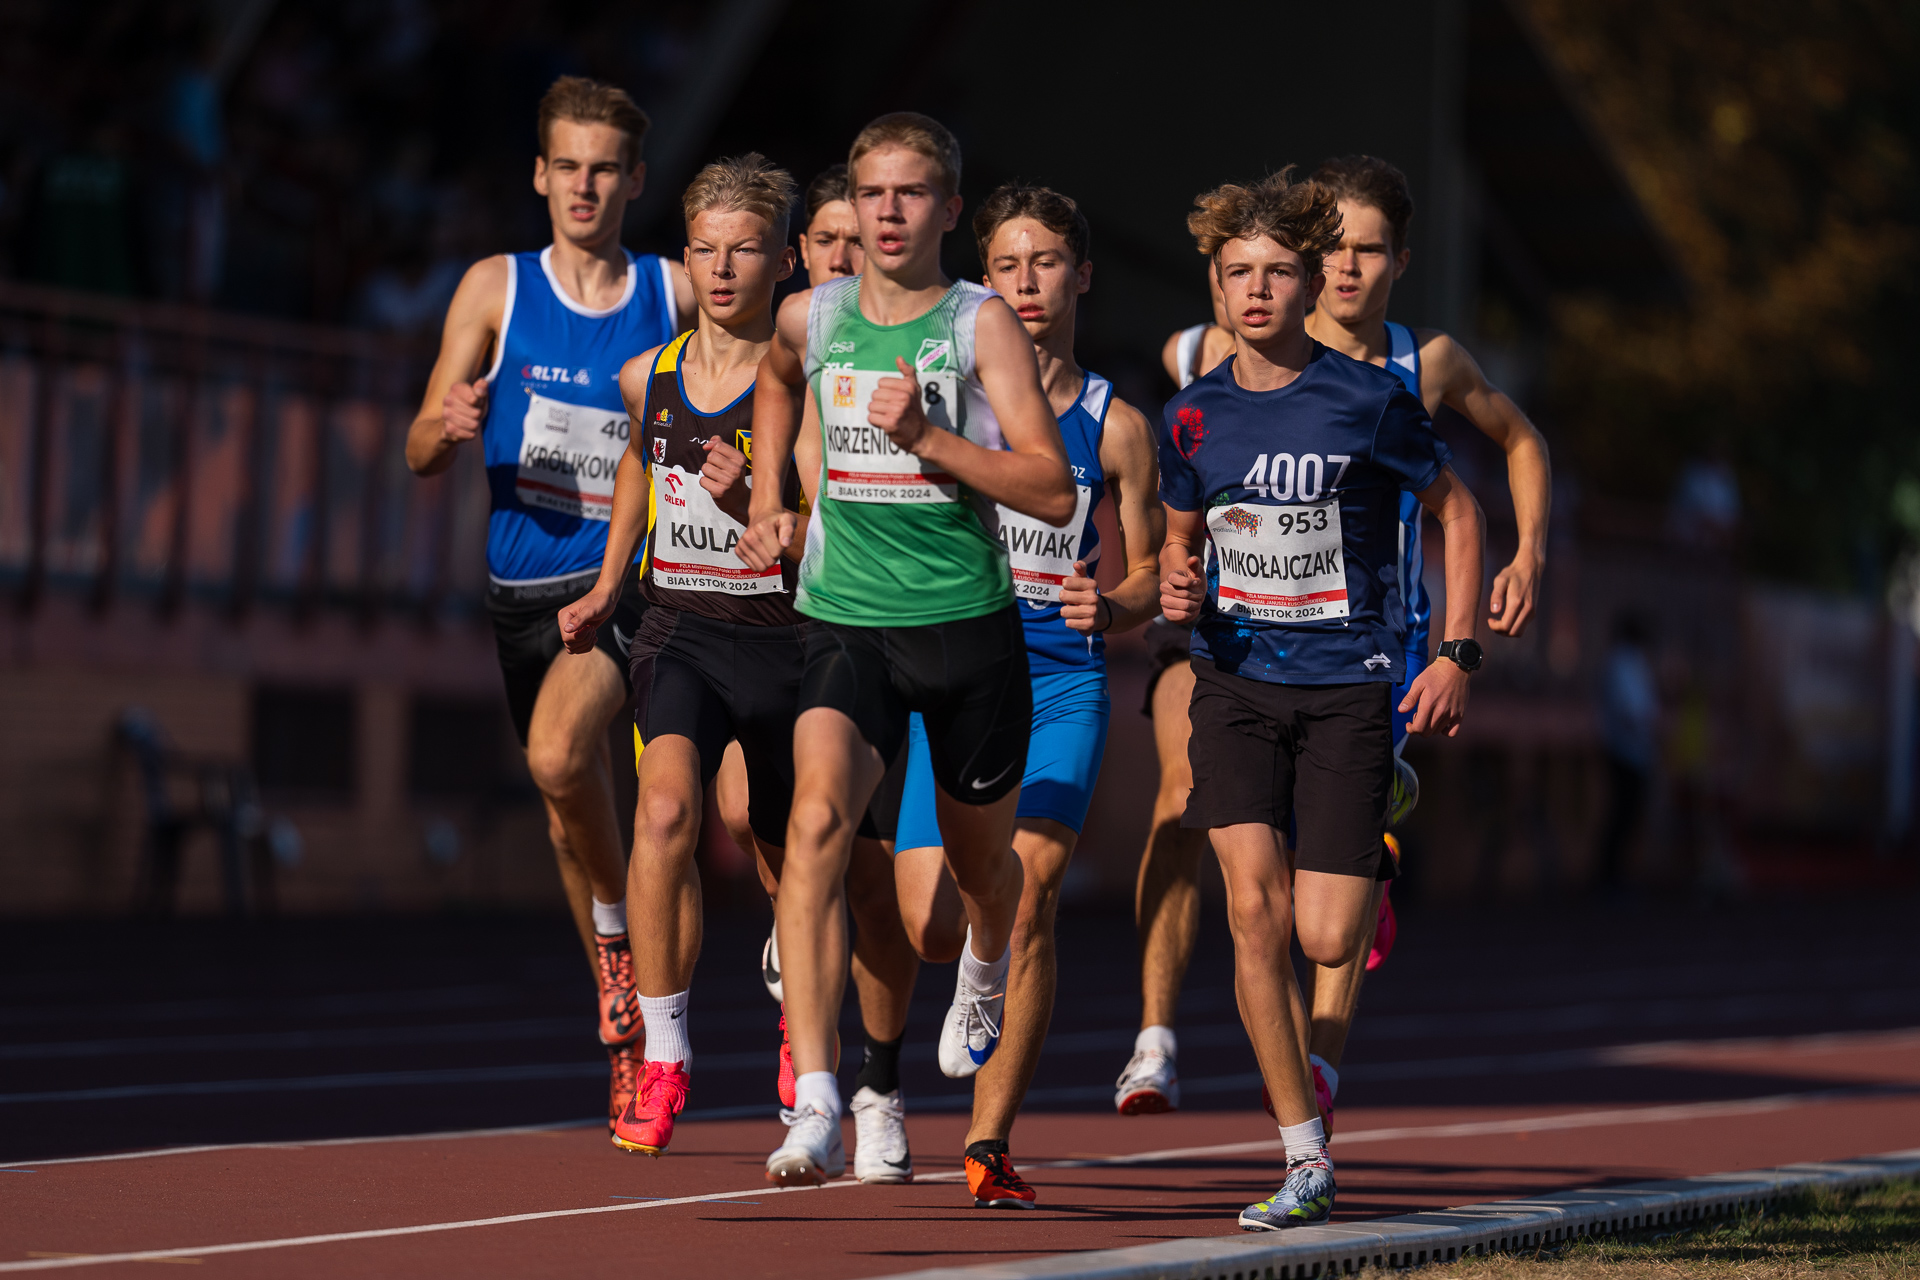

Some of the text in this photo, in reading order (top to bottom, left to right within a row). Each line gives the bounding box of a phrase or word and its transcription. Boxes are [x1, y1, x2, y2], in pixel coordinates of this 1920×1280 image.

[827, 424, 909, 456] KORZENIO
[664, 494, 686, 507] ORLEN
[838, 487, 931, 499] BIAŁYSTOK 2024
[1278, 509, 1328, 535] 953
[671, 522, 740, 553] KULA
[1221, 546, 1339, 580] MIKOŁAJCZAK
[667, 576, 757, 591] BIAŁYSTOK 2024
[1022, 584, 1050, 597] 2024
[1237, 603, 1325, 618] BIAŁYSTOK 2024
